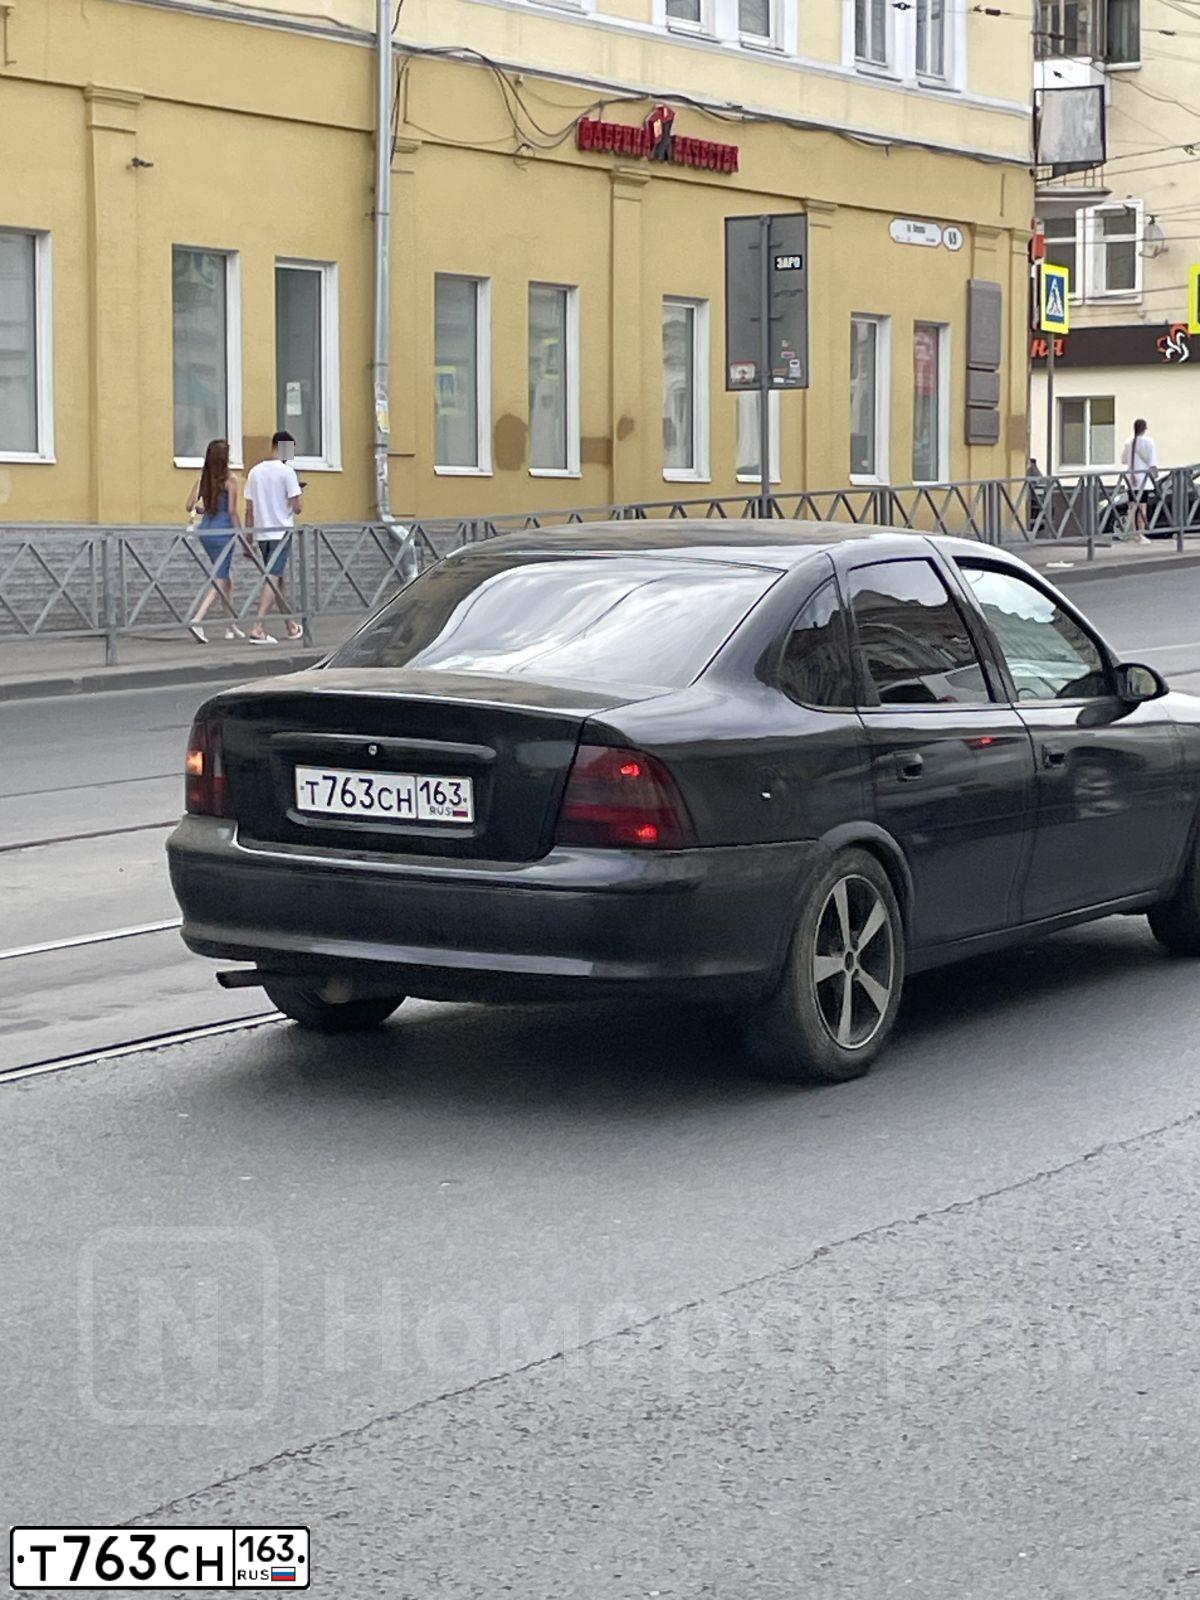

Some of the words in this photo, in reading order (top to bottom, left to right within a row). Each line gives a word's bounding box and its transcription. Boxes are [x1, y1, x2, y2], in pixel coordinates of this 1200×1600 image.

[305, 775, 412, 813] Т763СН
[420, 781, 462, 806] 163
[429, 806, 451, 816] RUS
